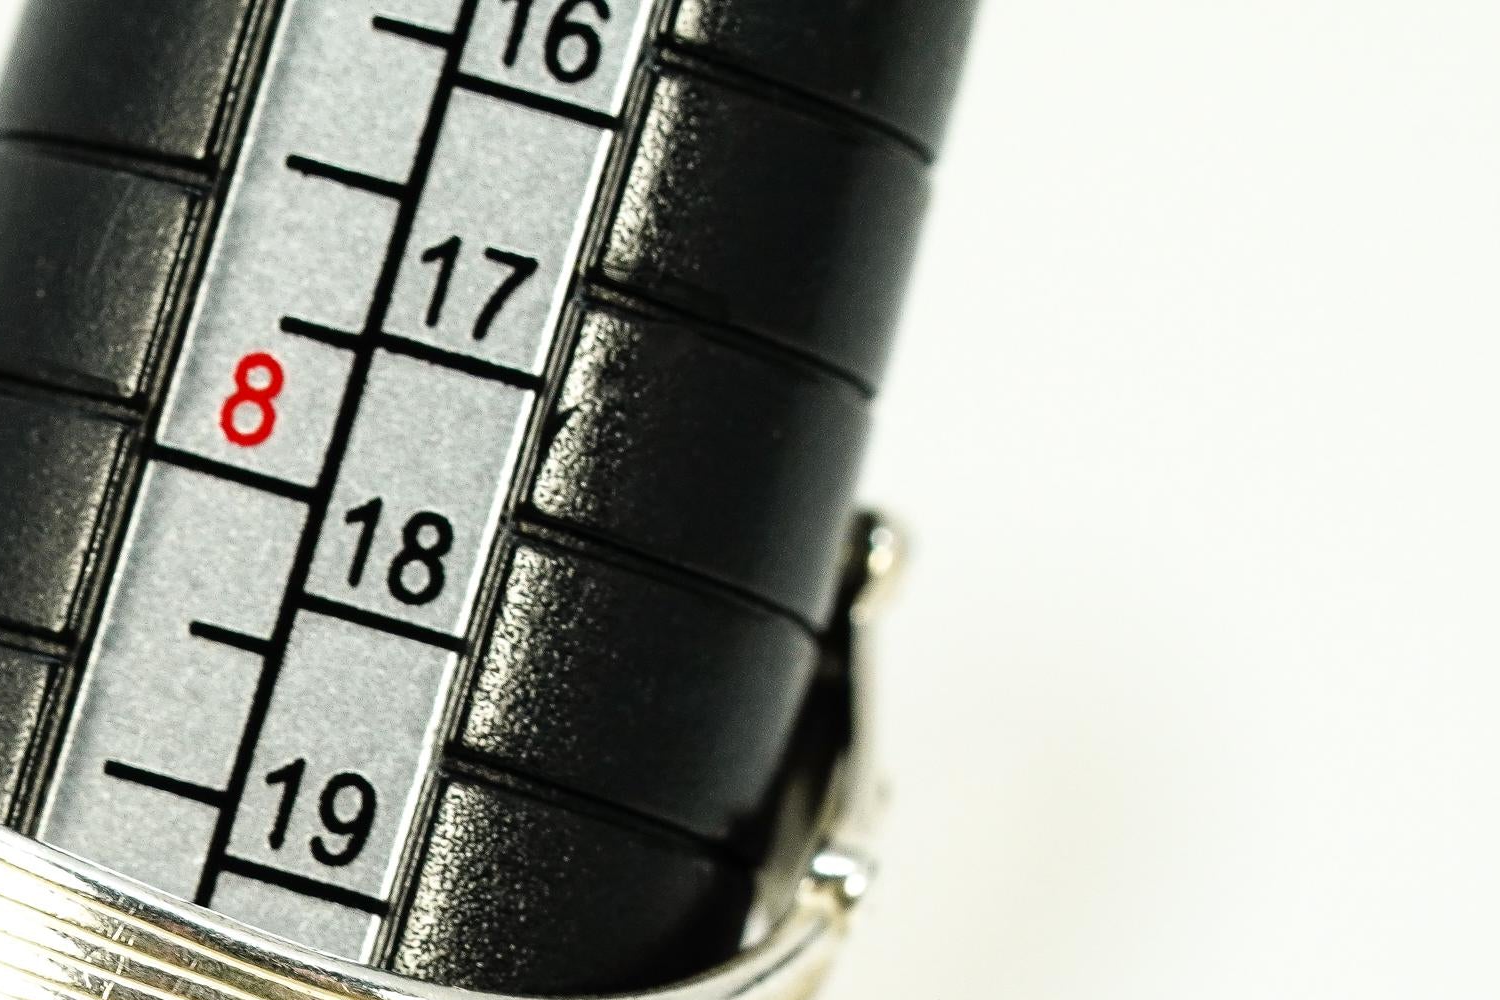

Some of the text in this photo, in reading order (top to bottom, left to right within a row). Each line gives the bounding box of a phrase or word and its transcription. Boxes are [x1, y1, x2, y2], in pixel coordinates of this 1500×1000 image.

[500, 0, 611, 84] 16
[421, 235, 539, 341] 17
[219, 351, 285, 448] 8
[345, 497, 454, 607] 18
[265, 758, 378, 868] 19
